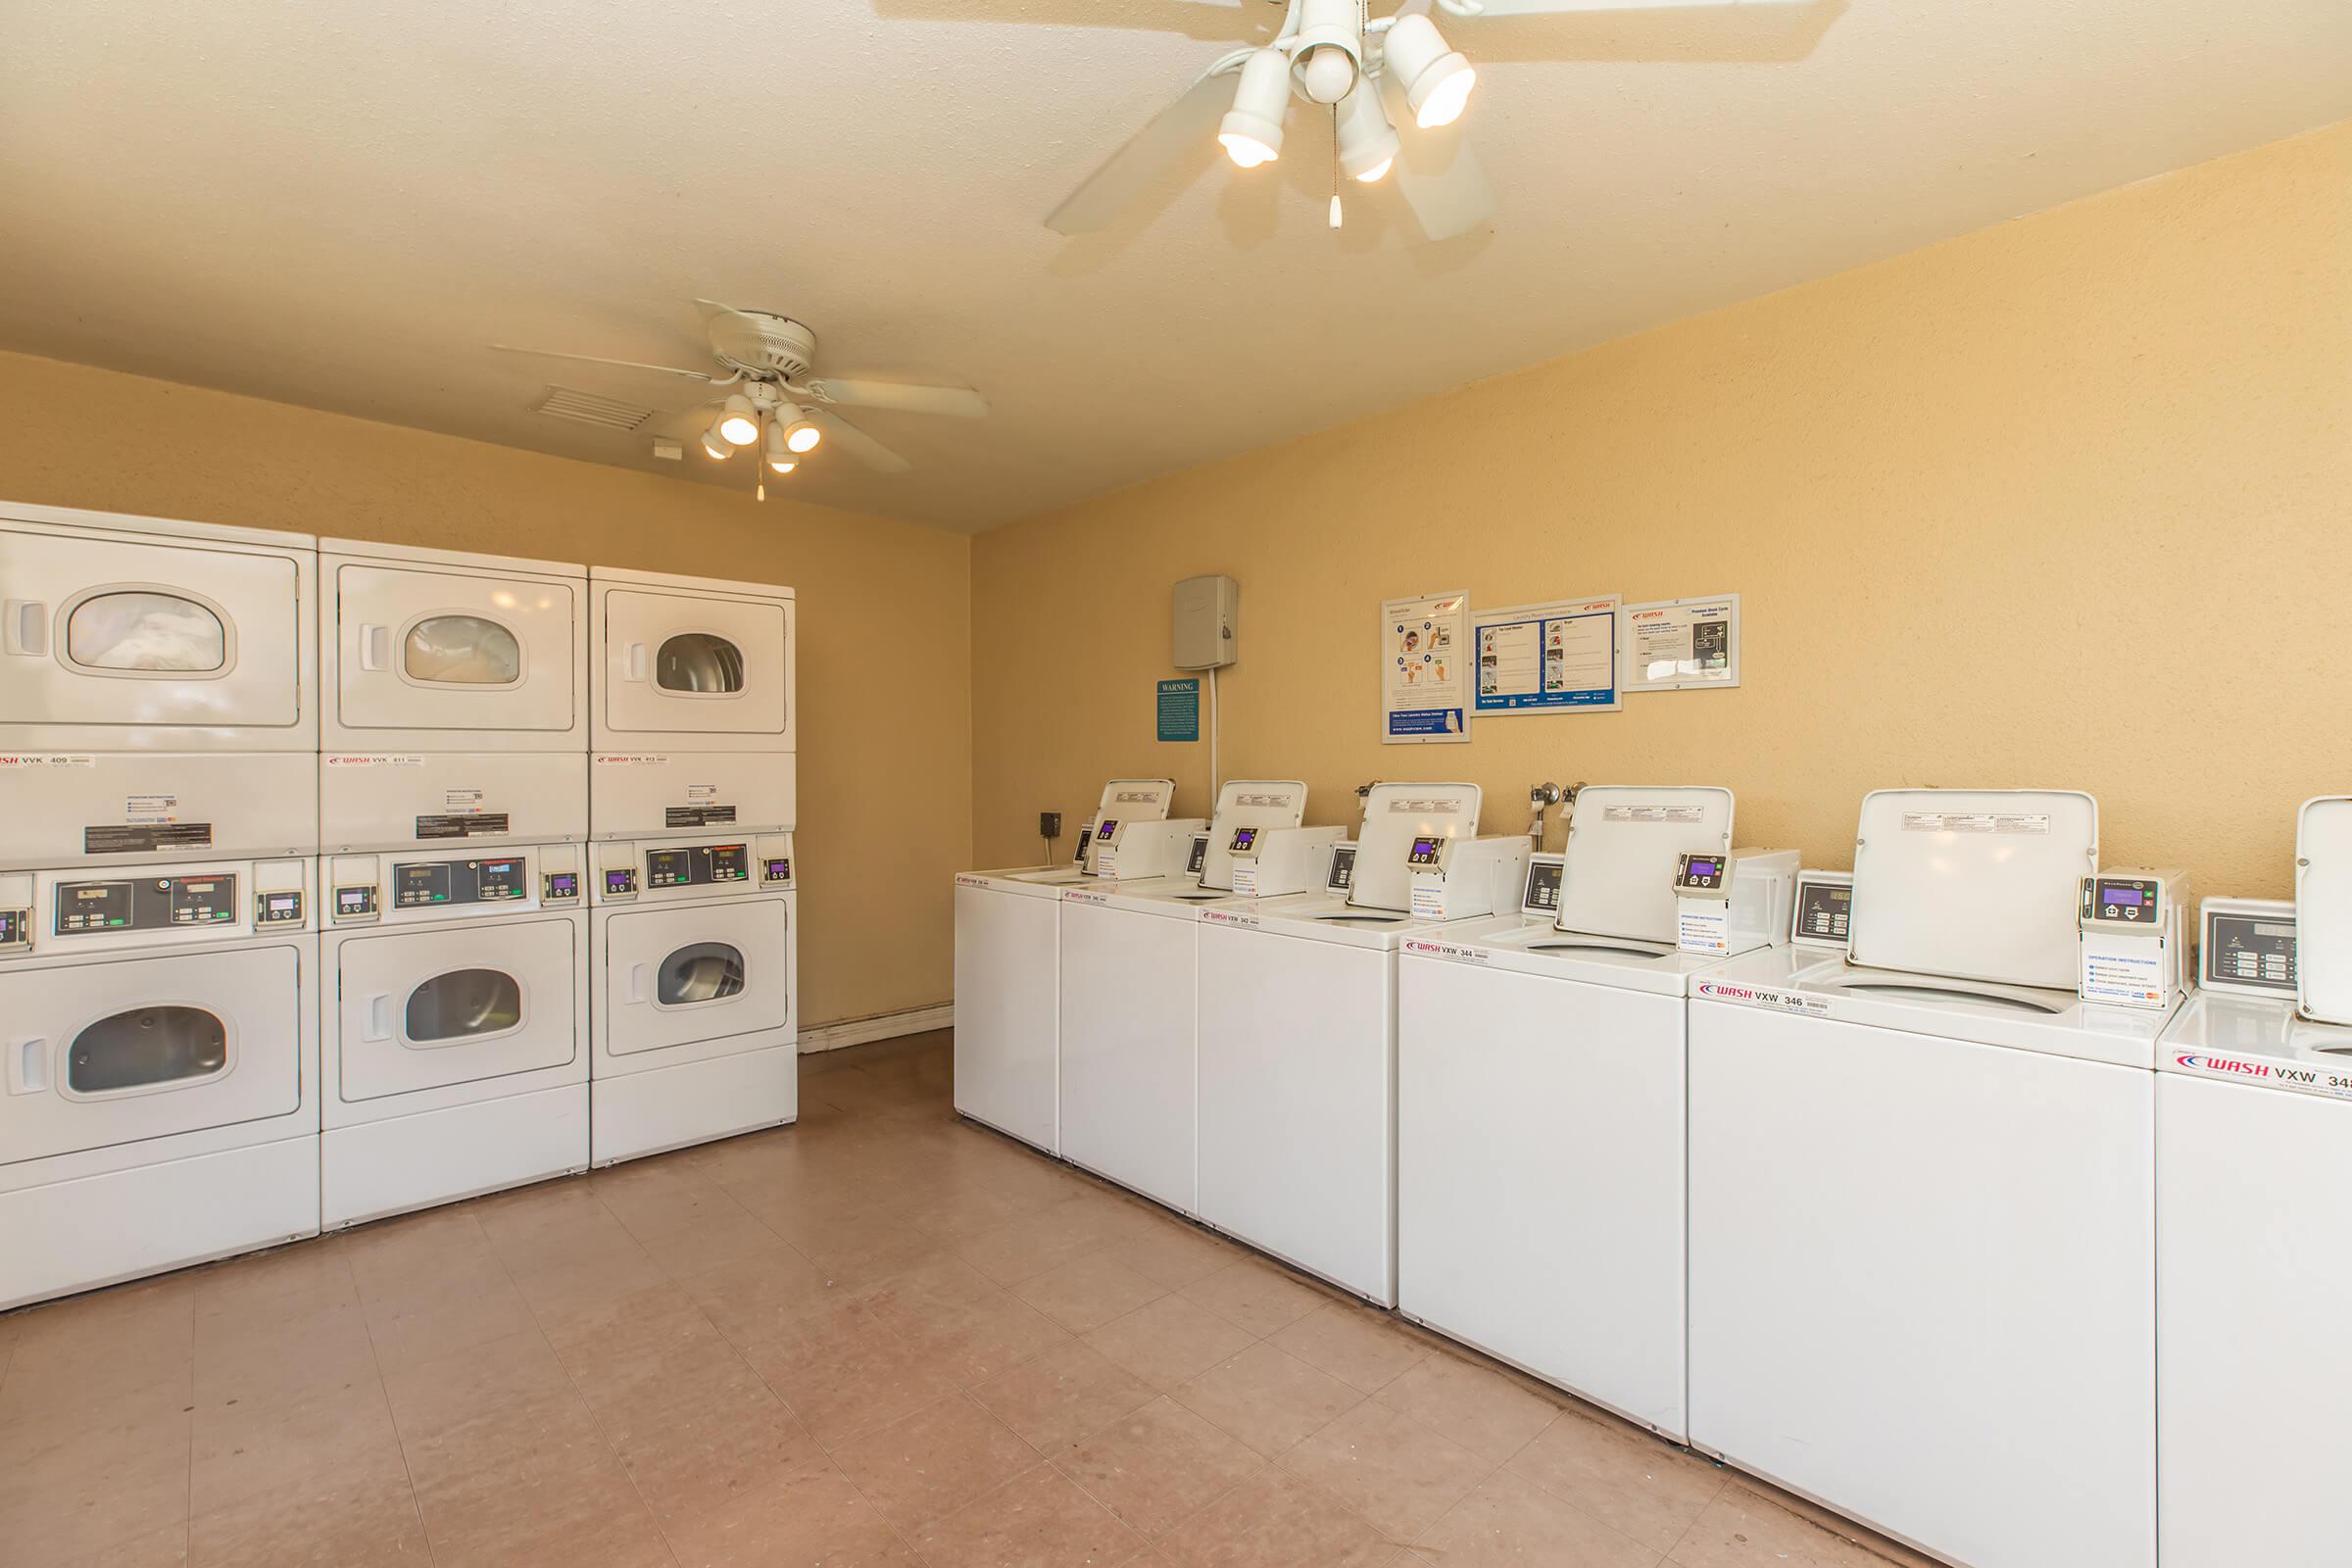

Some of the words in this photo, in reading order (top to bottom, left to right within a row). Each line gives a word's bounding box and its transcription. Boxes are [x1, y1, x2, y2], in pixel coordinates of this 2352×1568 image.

[1162, 683, 1193, 691] WARNING
[1417, 943, 1441, 952] WASH
[1717, 986, 1752, 999] WASH
[1755, 992, 1779, 1002] VXW
[1785, 996, 1803, 1006] 346
[2207, 1057, 2269, 1076] WASH
[2275, 1068, 2316, 1083] VXW
